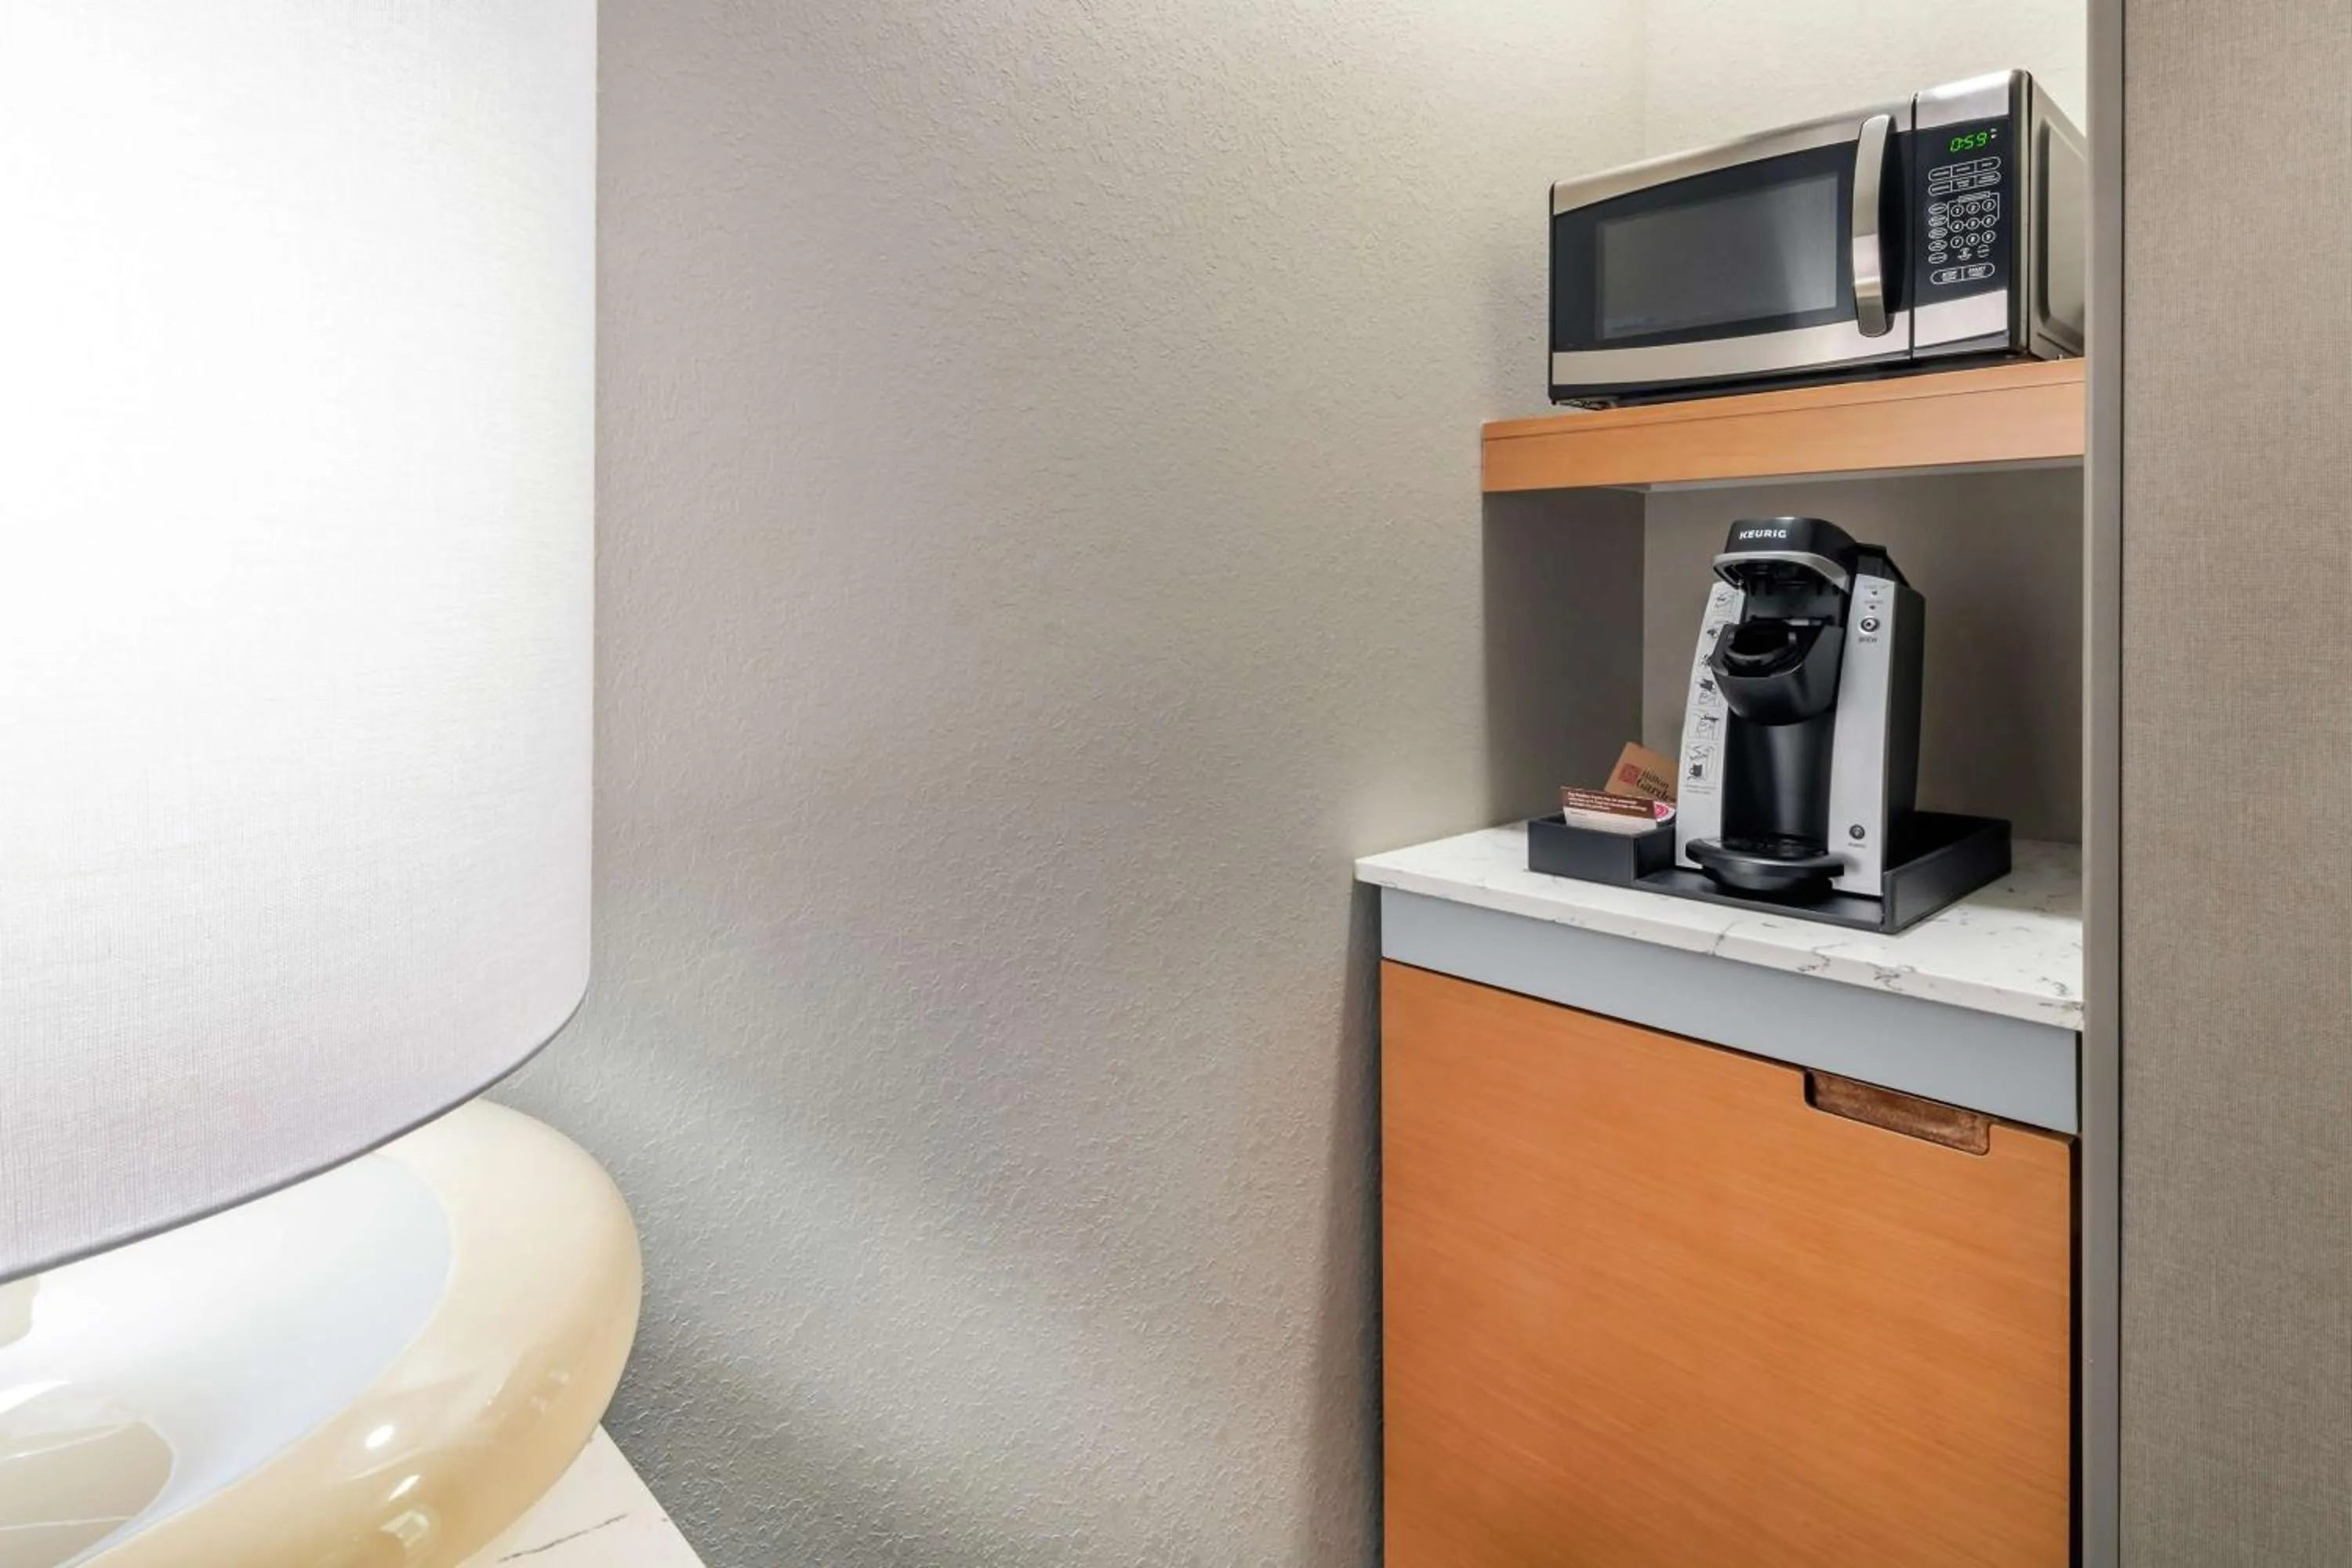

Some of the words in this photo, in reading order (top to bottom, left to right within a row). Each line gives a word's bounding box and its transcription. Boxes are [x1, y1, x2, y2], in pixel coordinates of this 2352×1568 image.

[1950, 131, 1987, 151] 0:59
[1738, 529, 1787, 539] KEURIG
[1642, 770, 1669, 789] Hilton
